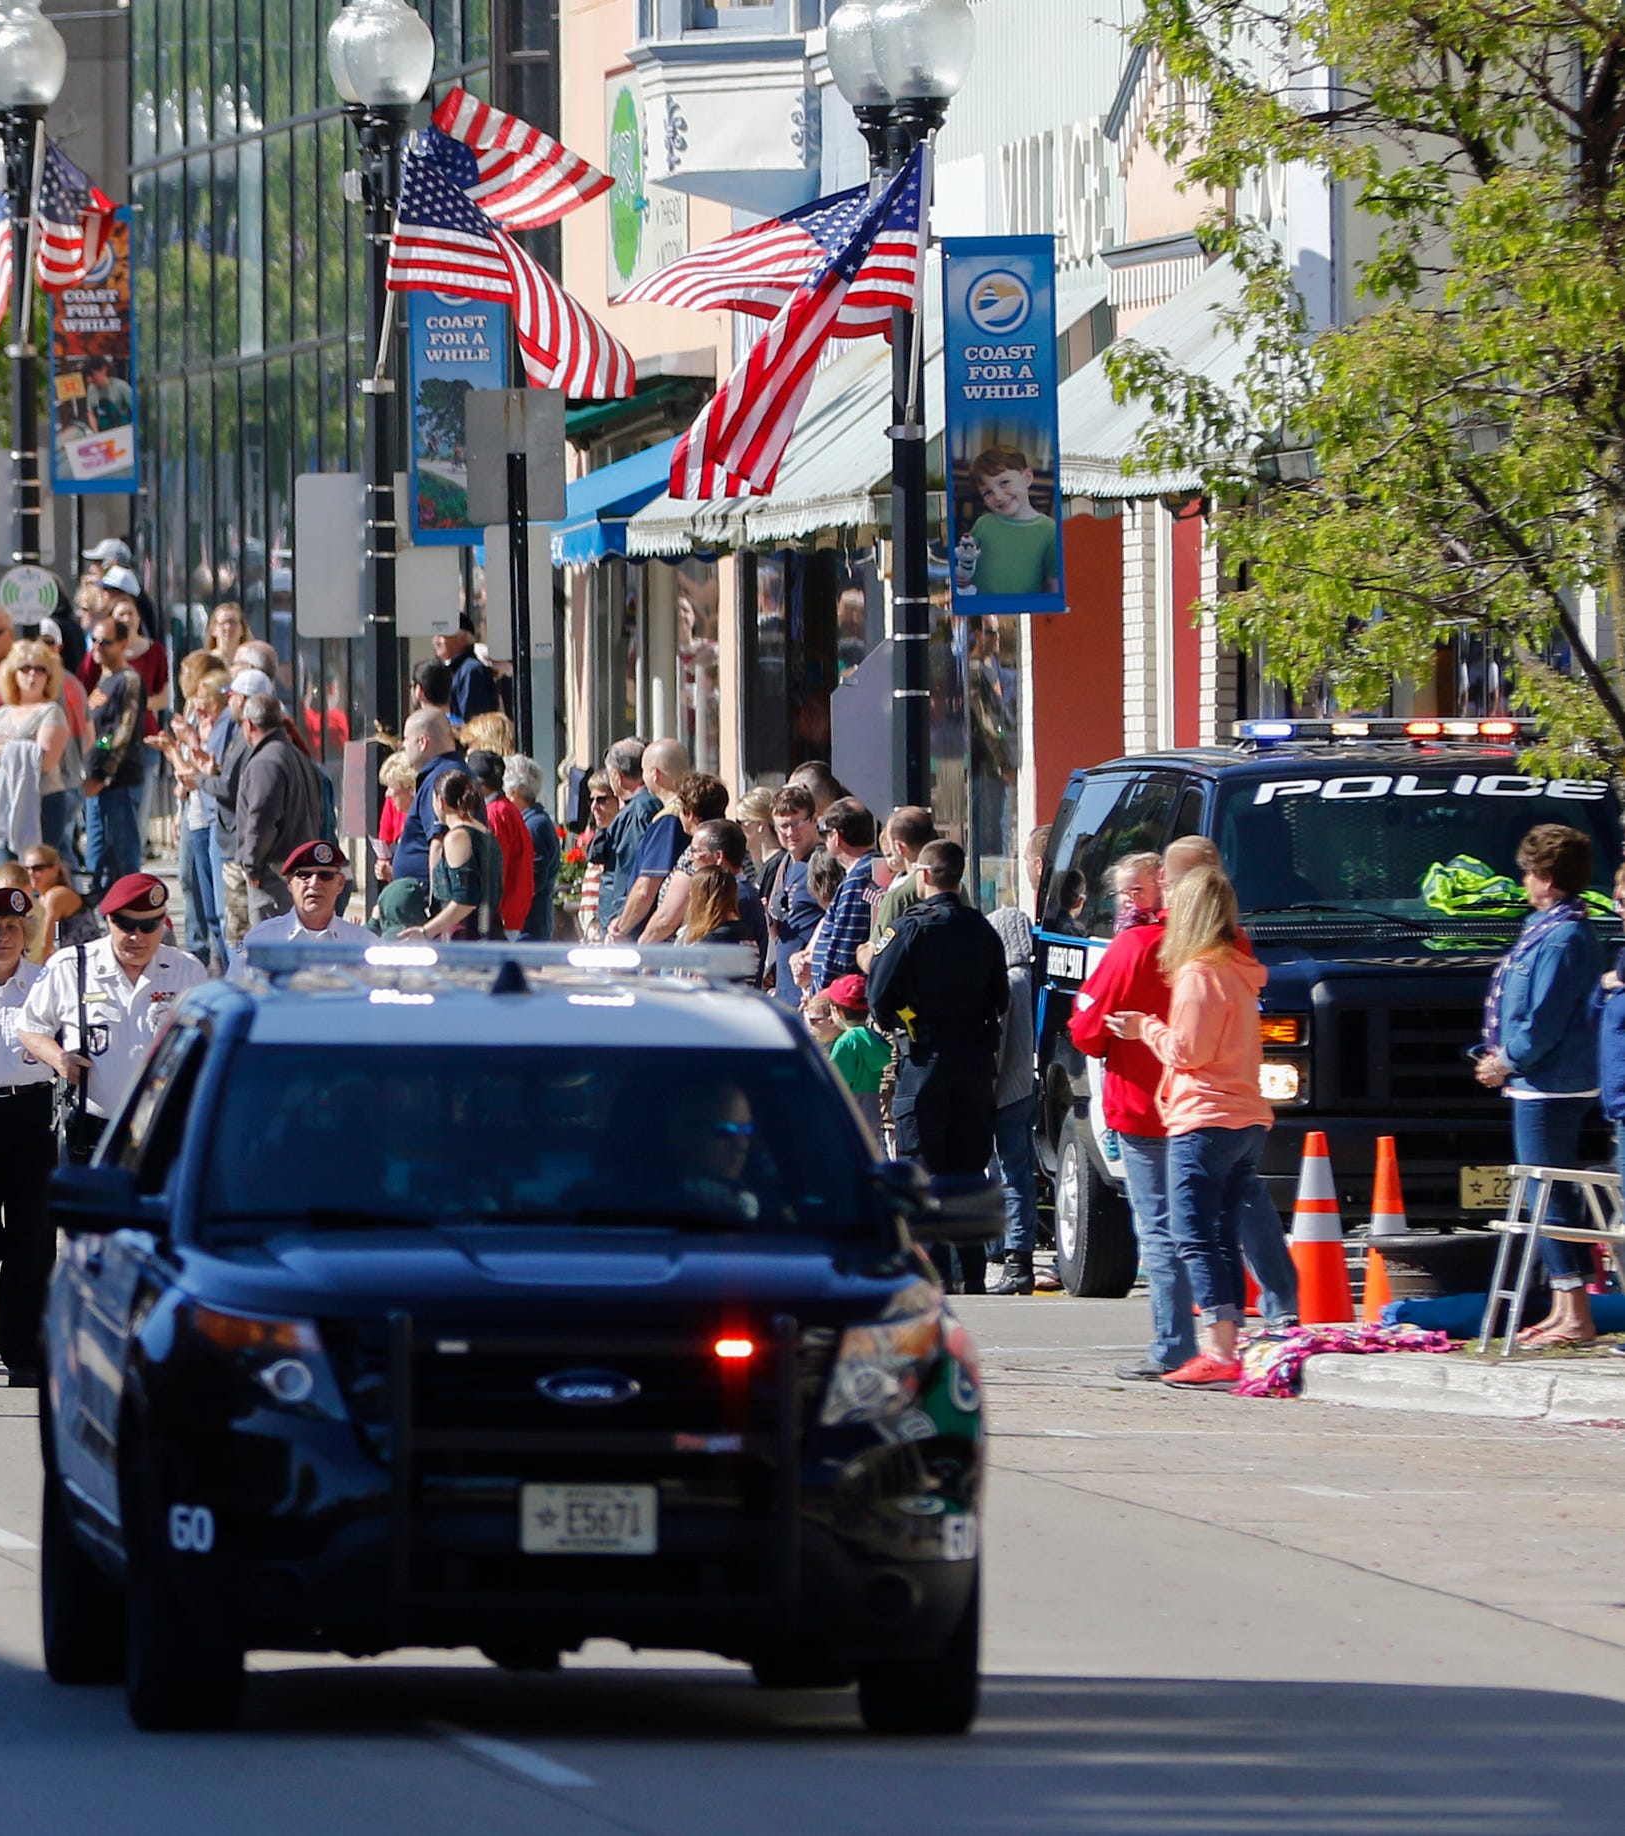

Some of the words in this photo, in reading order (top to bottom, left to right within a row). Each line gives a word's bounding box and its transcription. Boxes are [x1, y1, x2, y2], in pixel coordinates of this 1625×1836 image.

[62, 288, 119, 303] COAST
[65, 304, 102, 318] FOR
[103, 303, 117, 317] A
[61, 318, 121, 332] WHILE
[426, 314, 488, 330] COAST
[429, 332, 468, 346] FOR
[472, 332, 485, 345] A
[424, 348, 490, 362] WHILE
[964, 345, 1036, 361] COAST
[968, 365, 1014, 380] FOR
[1017, 364, 1034, 379] A
[962, 383, 1039, 400] WHILE
[1253, 774, 1609, 805] POLICE
[169, 1504, 215, 1552] 60
[566, 1502, 641, 1538] E5671
